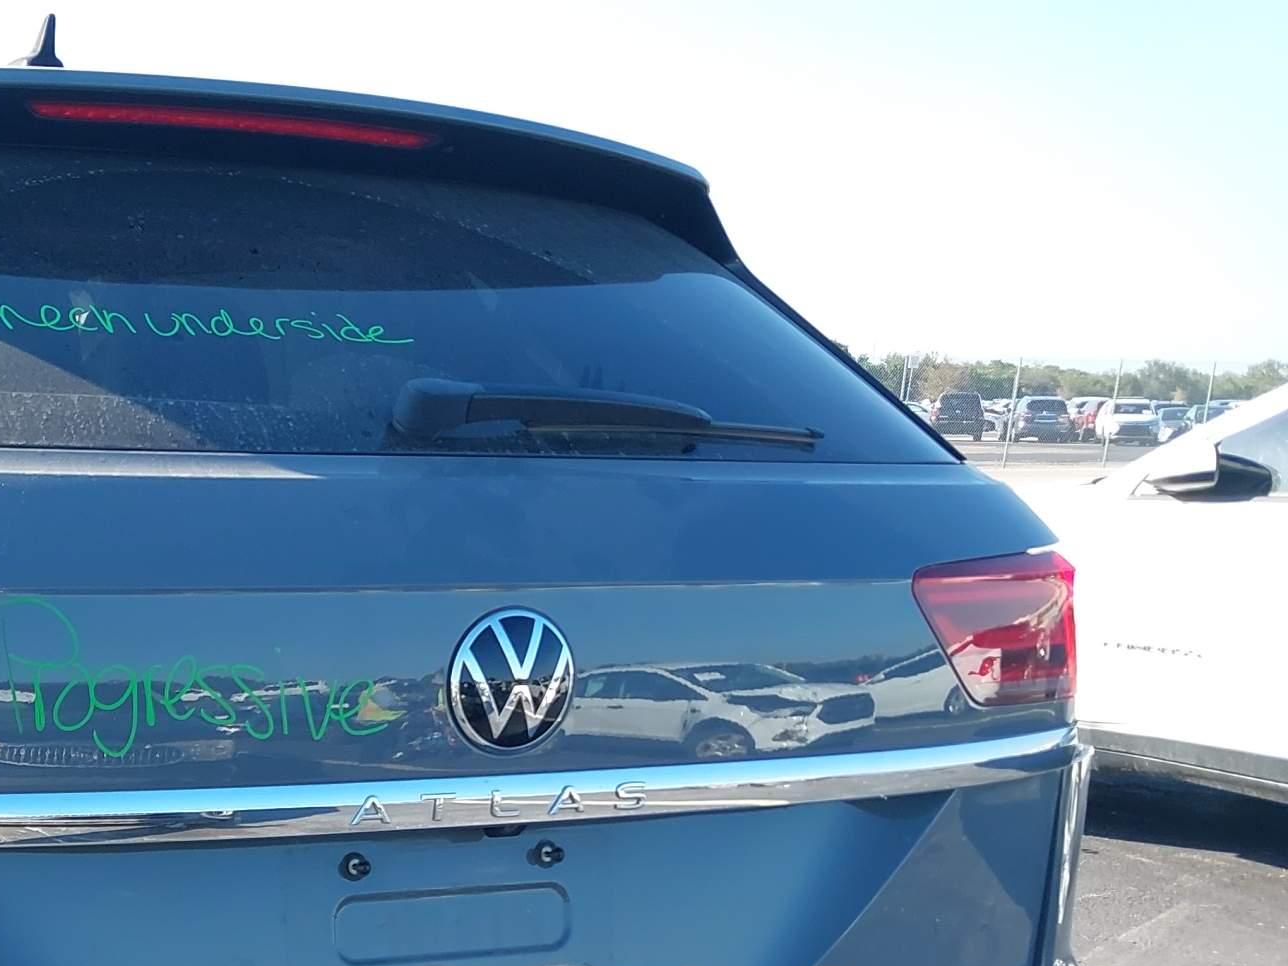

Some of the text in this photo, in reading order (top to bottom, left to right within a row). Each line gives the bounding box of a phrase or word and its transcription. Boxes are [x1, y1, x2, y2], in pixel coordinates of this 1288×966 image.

[144, 308, 414, 344] underside
[0, 598, 389, 757] Progressive
[351, 781, 647, 827] ATLAS
